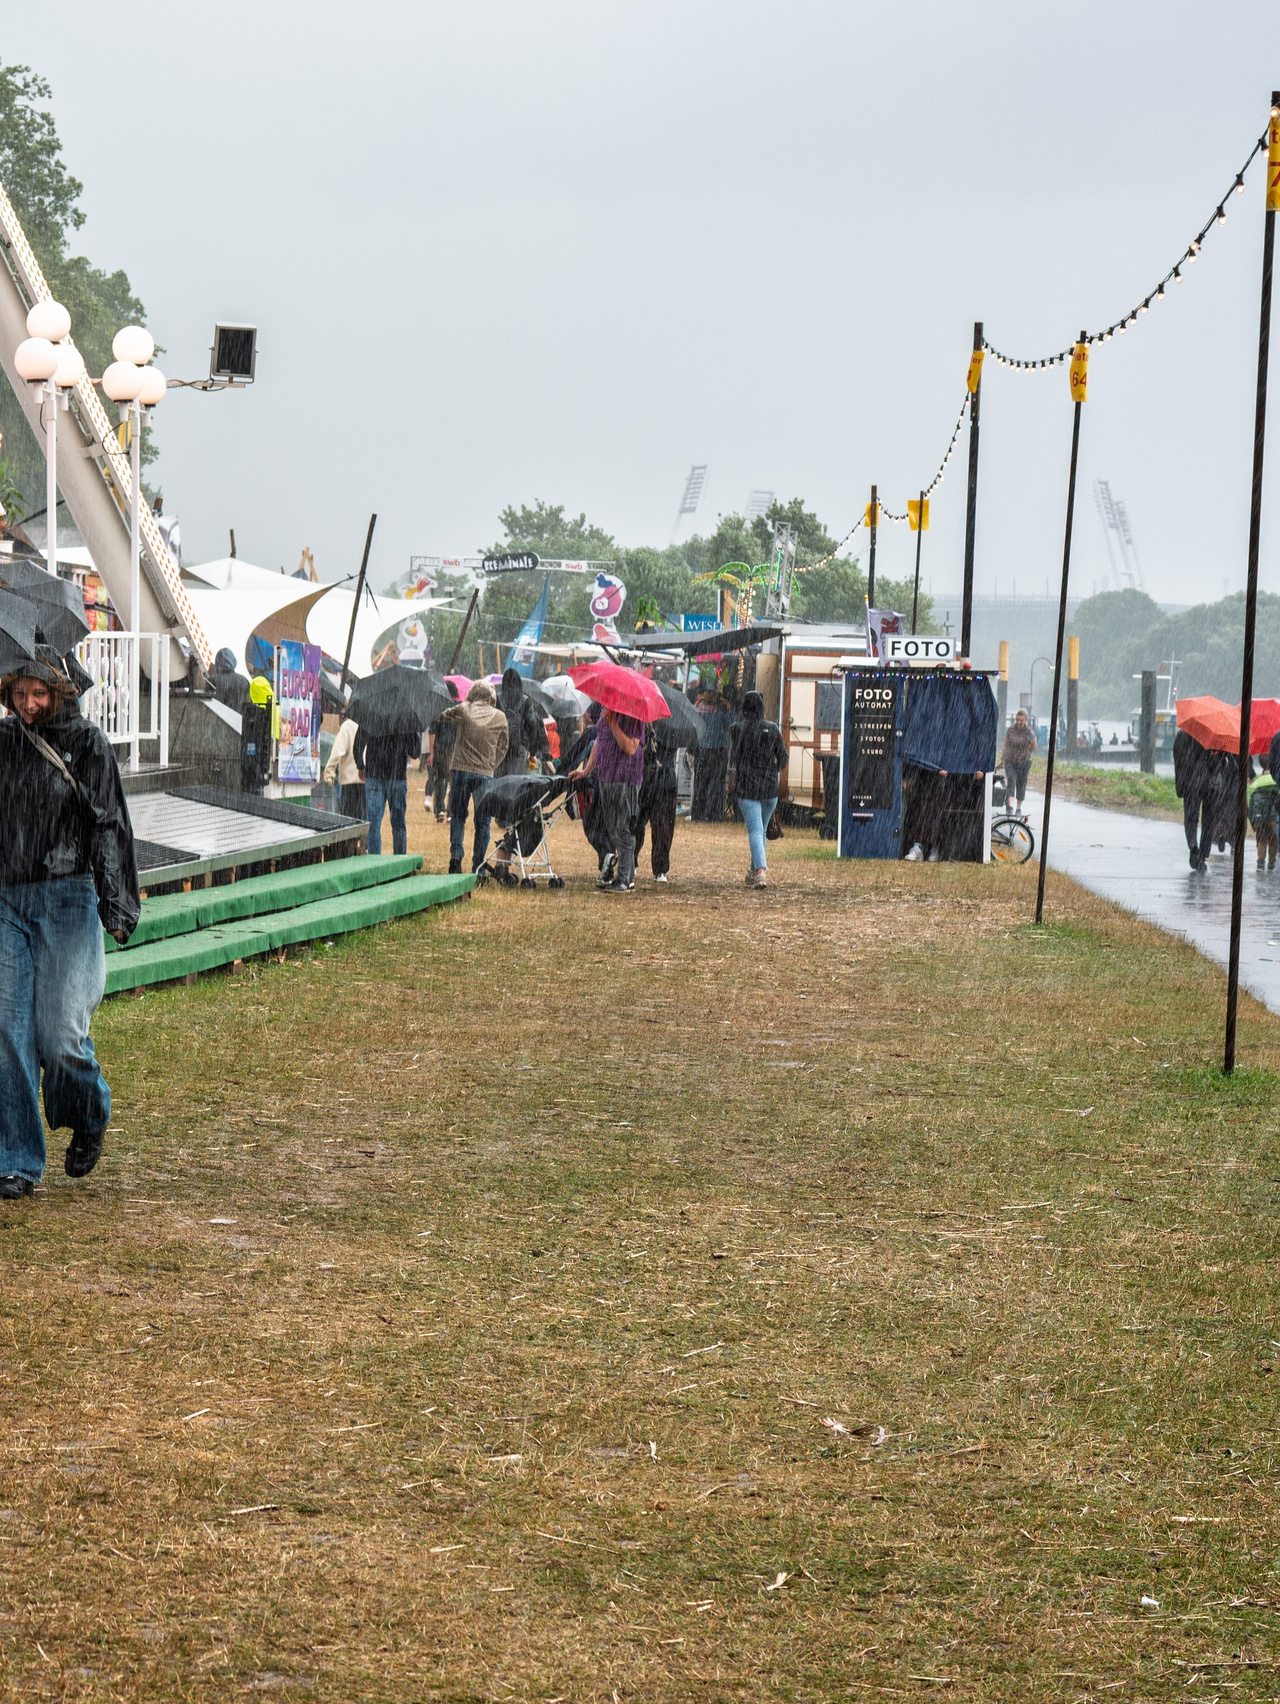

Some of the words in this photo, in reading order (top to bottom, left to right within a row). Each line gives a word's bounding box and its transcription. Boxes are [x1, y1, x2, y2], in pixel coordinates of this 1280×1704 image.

[1072, 371, 1087, 387] 64
[891, 641, 950, 656] FOTO
[282, 669, 320, 699] EUROPA
[855, 689, 892, 700] FOTO
[290, 708, 310, 737] RAD
